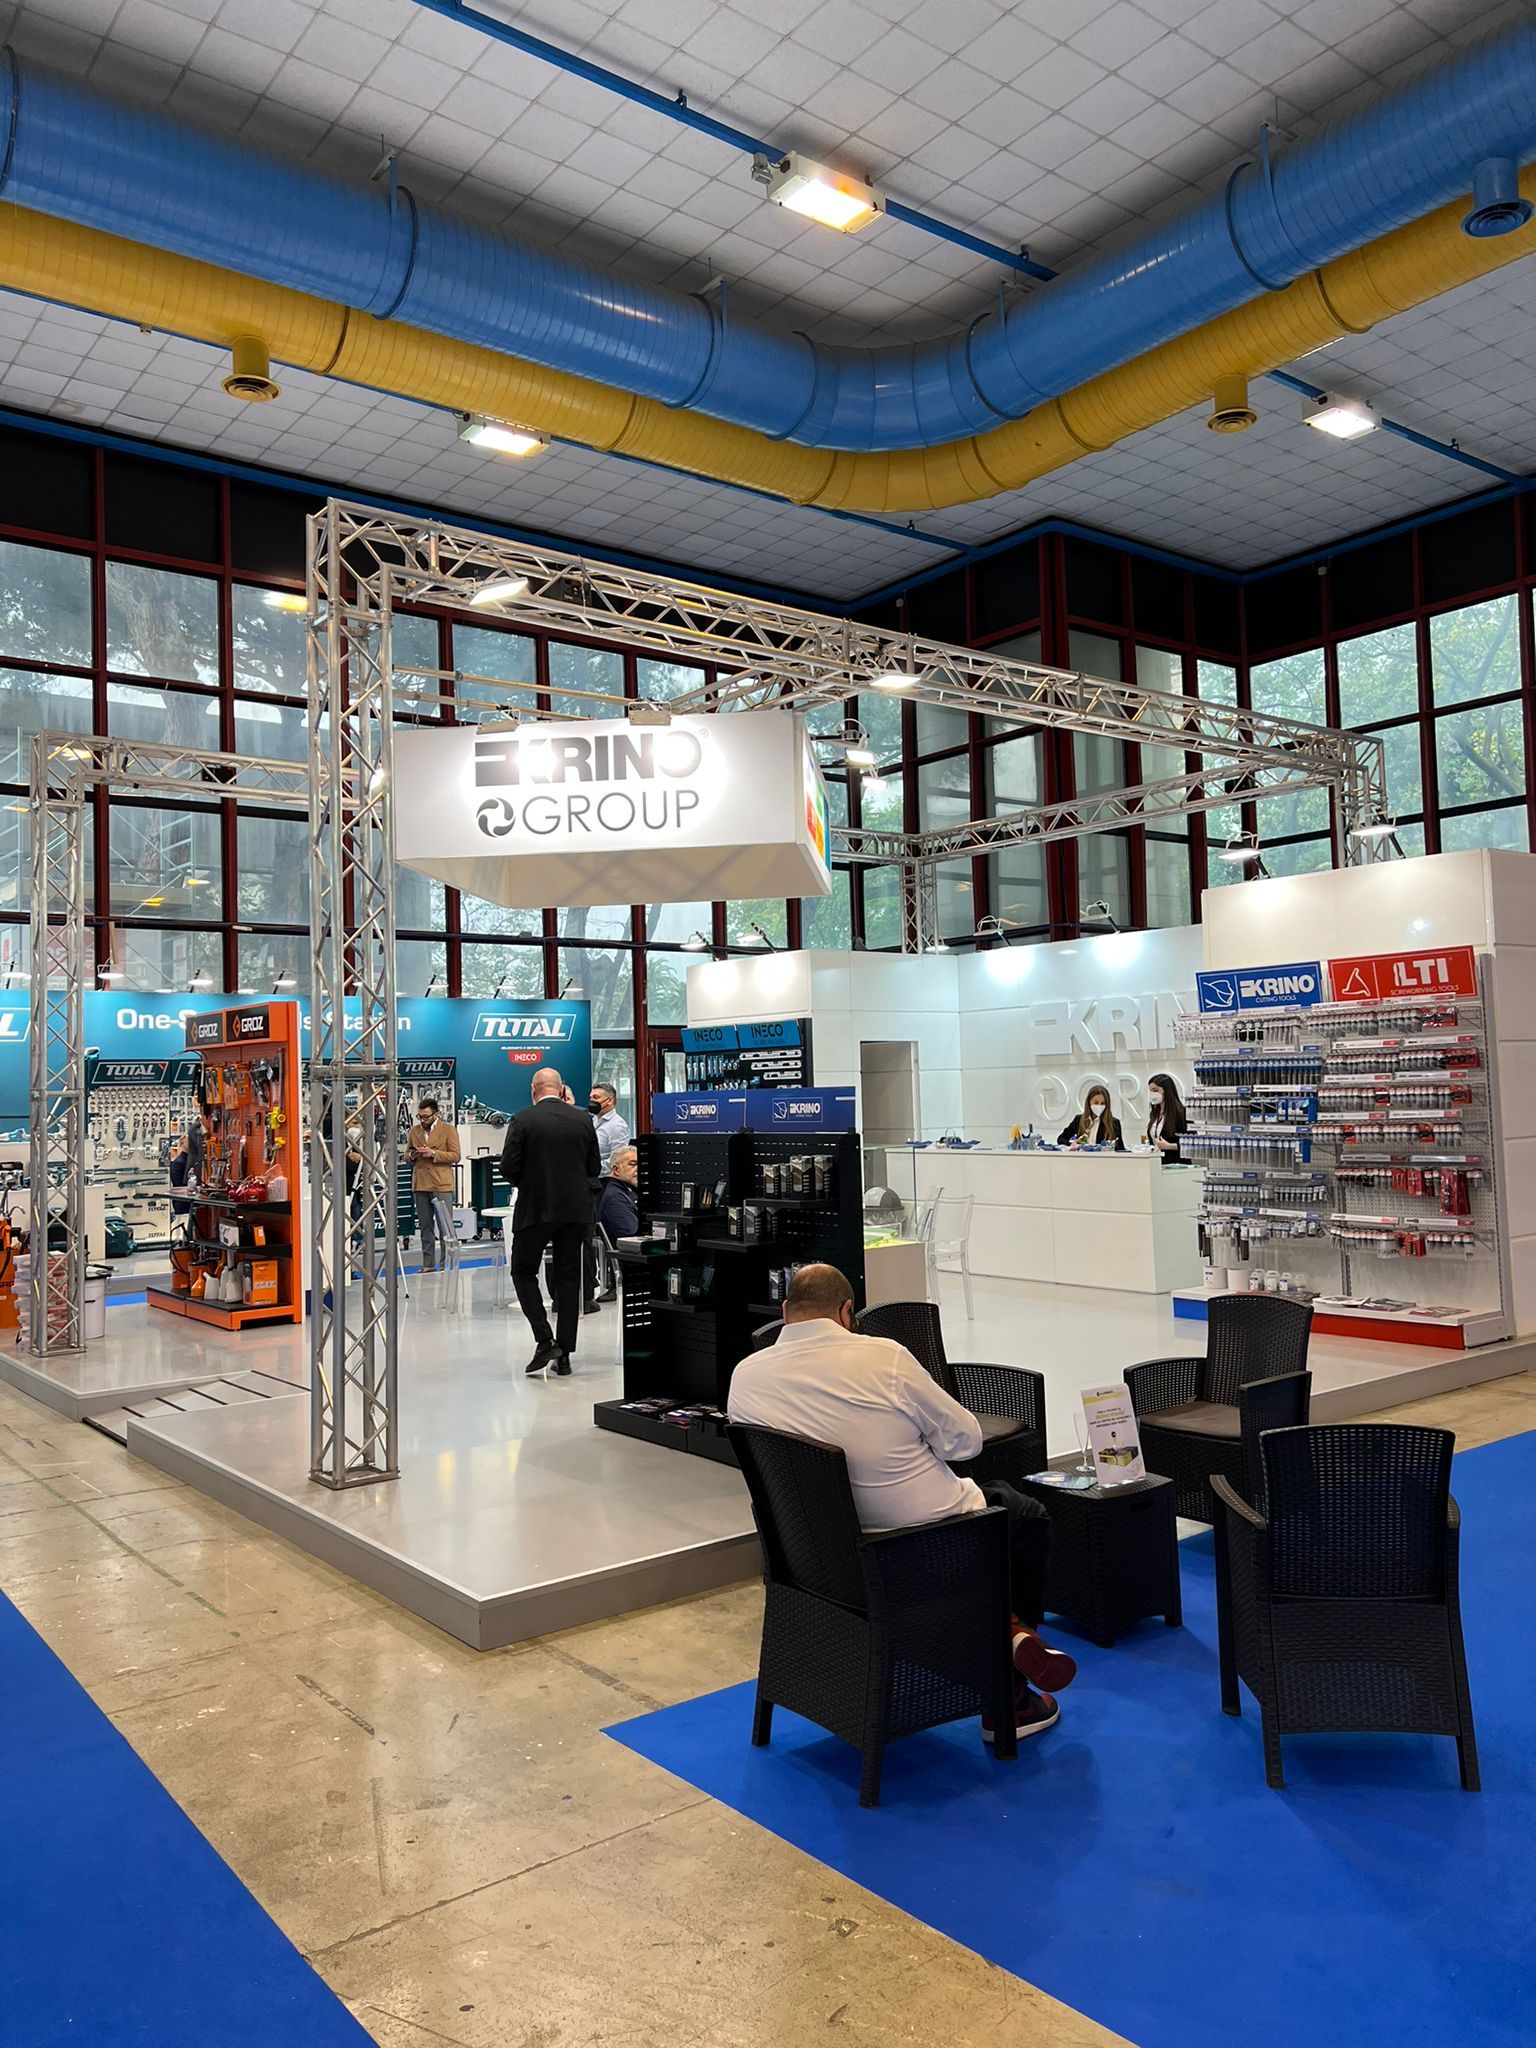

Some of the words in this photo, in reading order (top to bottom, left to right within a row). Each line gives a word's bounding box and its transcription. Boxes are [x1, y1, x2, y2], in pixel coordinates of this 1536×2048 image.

[522, 789, 699, 835] GROUP
[1240, 974, 1314, 998] KRINO
[1391, 986, 1438, 996] SCREWDRIVING
[1438, 985, 1459, 993] TOOLS
[198, 1023, 218, 1038] GROZ
[241, 1015, 264, 1033] GROZ
[482, 1017, 566, 1037] TOTAL
[751, 1023, 783, 1038] INECO
[694, 1028, 722, 1042] INECO
[514, 1053, 537, 1062] INECO
[105, 1064, 155, 1076] TOTAL
[404, 1062, 444, 1073] TOTAL
[690, 1104, 717, 1116] KRINO
[789, 1102, 820, 1115] KRINO
